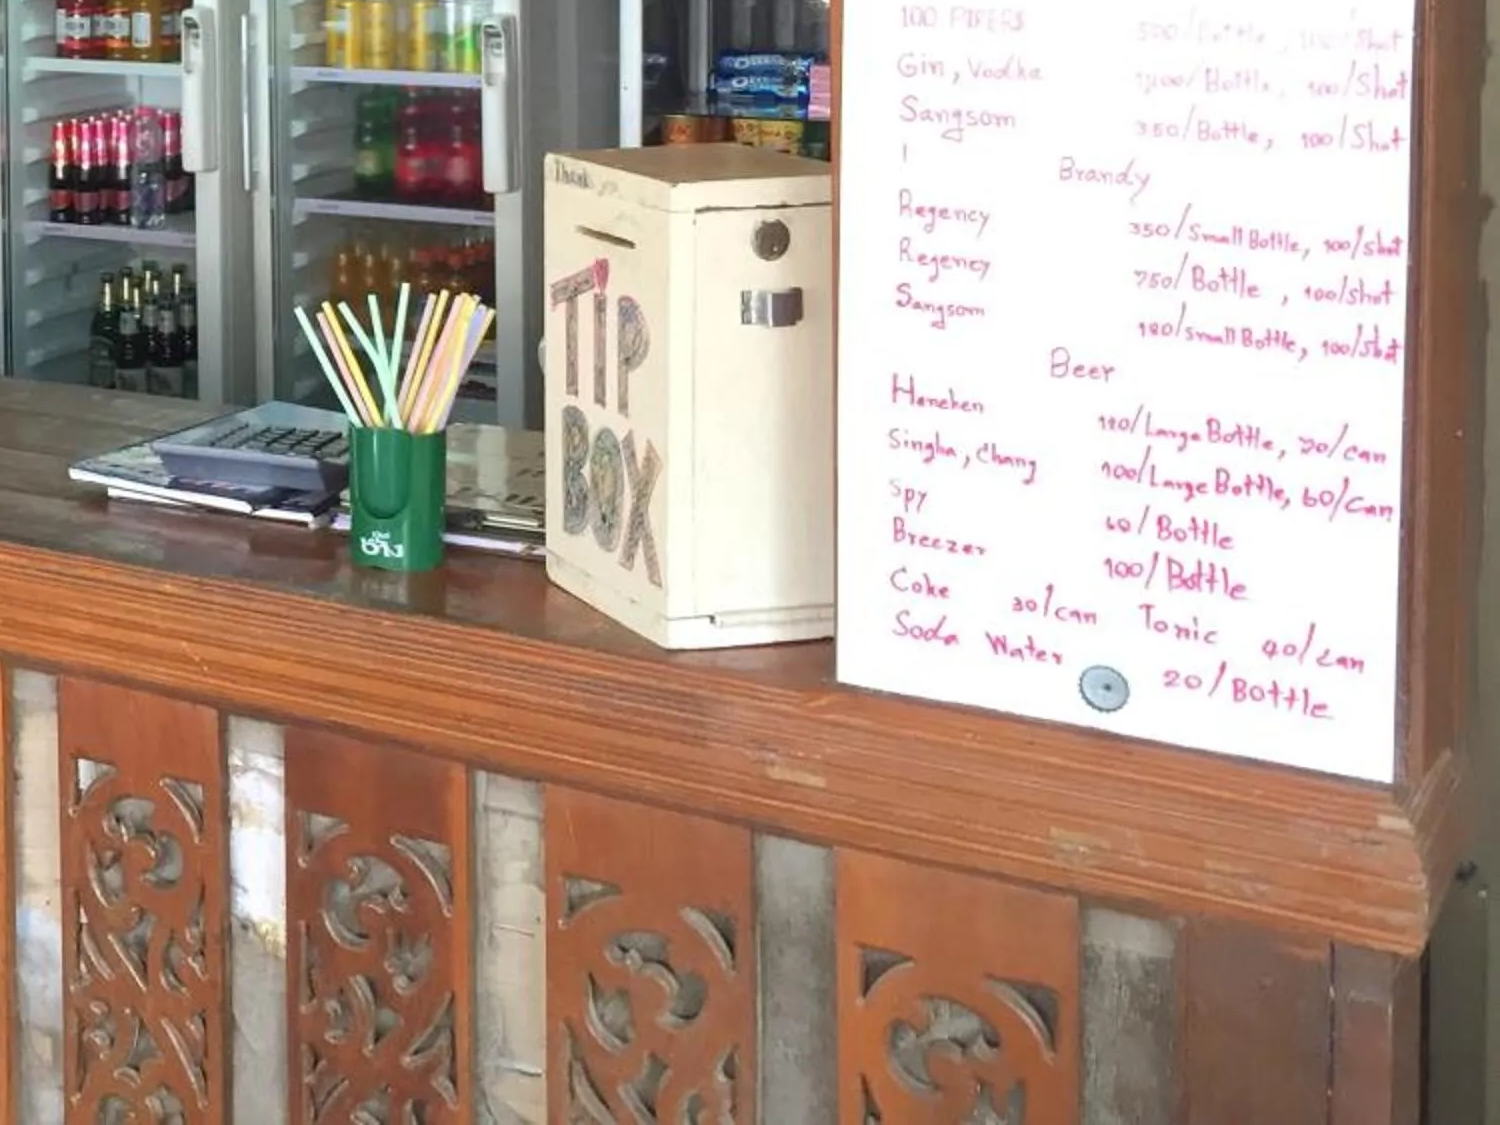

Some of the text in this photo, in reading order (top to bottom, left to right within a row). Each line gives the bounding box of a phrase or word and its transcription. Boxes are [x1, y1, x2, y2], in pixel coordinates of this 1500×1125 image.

[899, 94, 1017, 143] Sangsom
[1058, 155, 1151, 207] Brandy
[898, 188, 991, 240] Regency
[898, 236, 991, 284] Regency
[895, 282, 986, 330] Sangsom
[550, 257, 651, 420] TIP
[1049, 346, 1116, 383] Beer
[561, 404, 663, 588] BOX
[891, 609, 960, 647] Soda
[1138, 602, 1219, 645] Tonic
